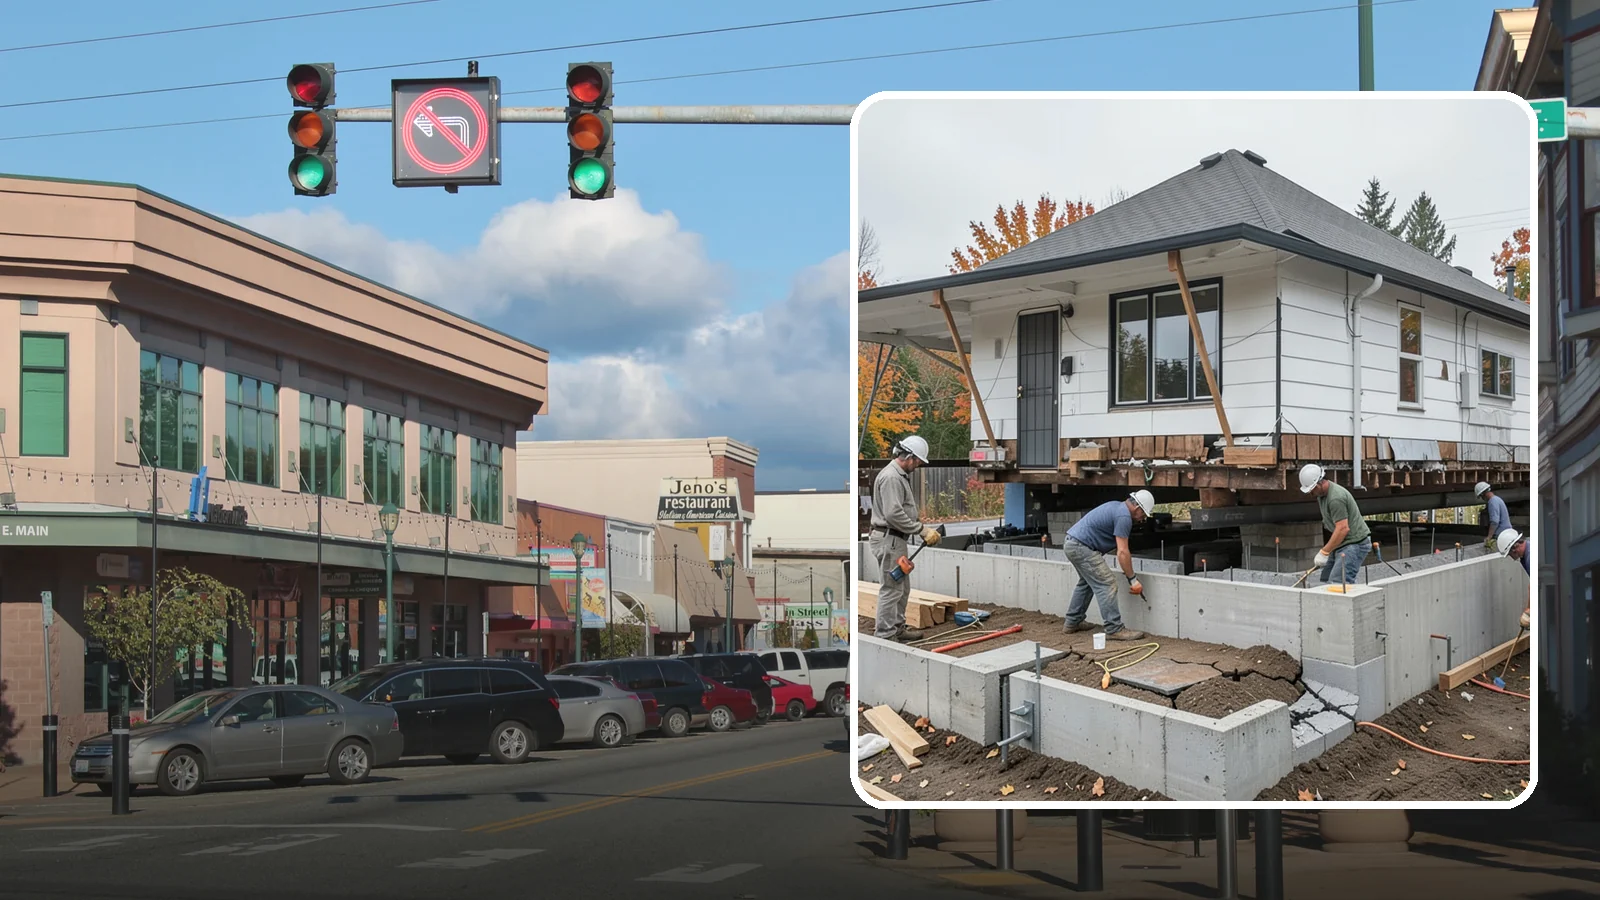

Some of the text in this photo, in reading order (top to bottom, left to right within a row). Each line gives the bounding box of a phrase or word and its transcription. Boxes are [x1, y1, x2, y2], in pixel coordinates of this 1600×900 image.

[670, 480, 727, 495] Jeno's
[665, 496, 731, 509] restaurant
[659, 509, 682, 520] Italian
[686, 509, 715, 519] American
[715, 509, 737, 519] Cuisine
[2, 525, 49, 536] E. MAIN
[785, 607, 829, 617] in Street
[791, 619, 824, 627] lass
